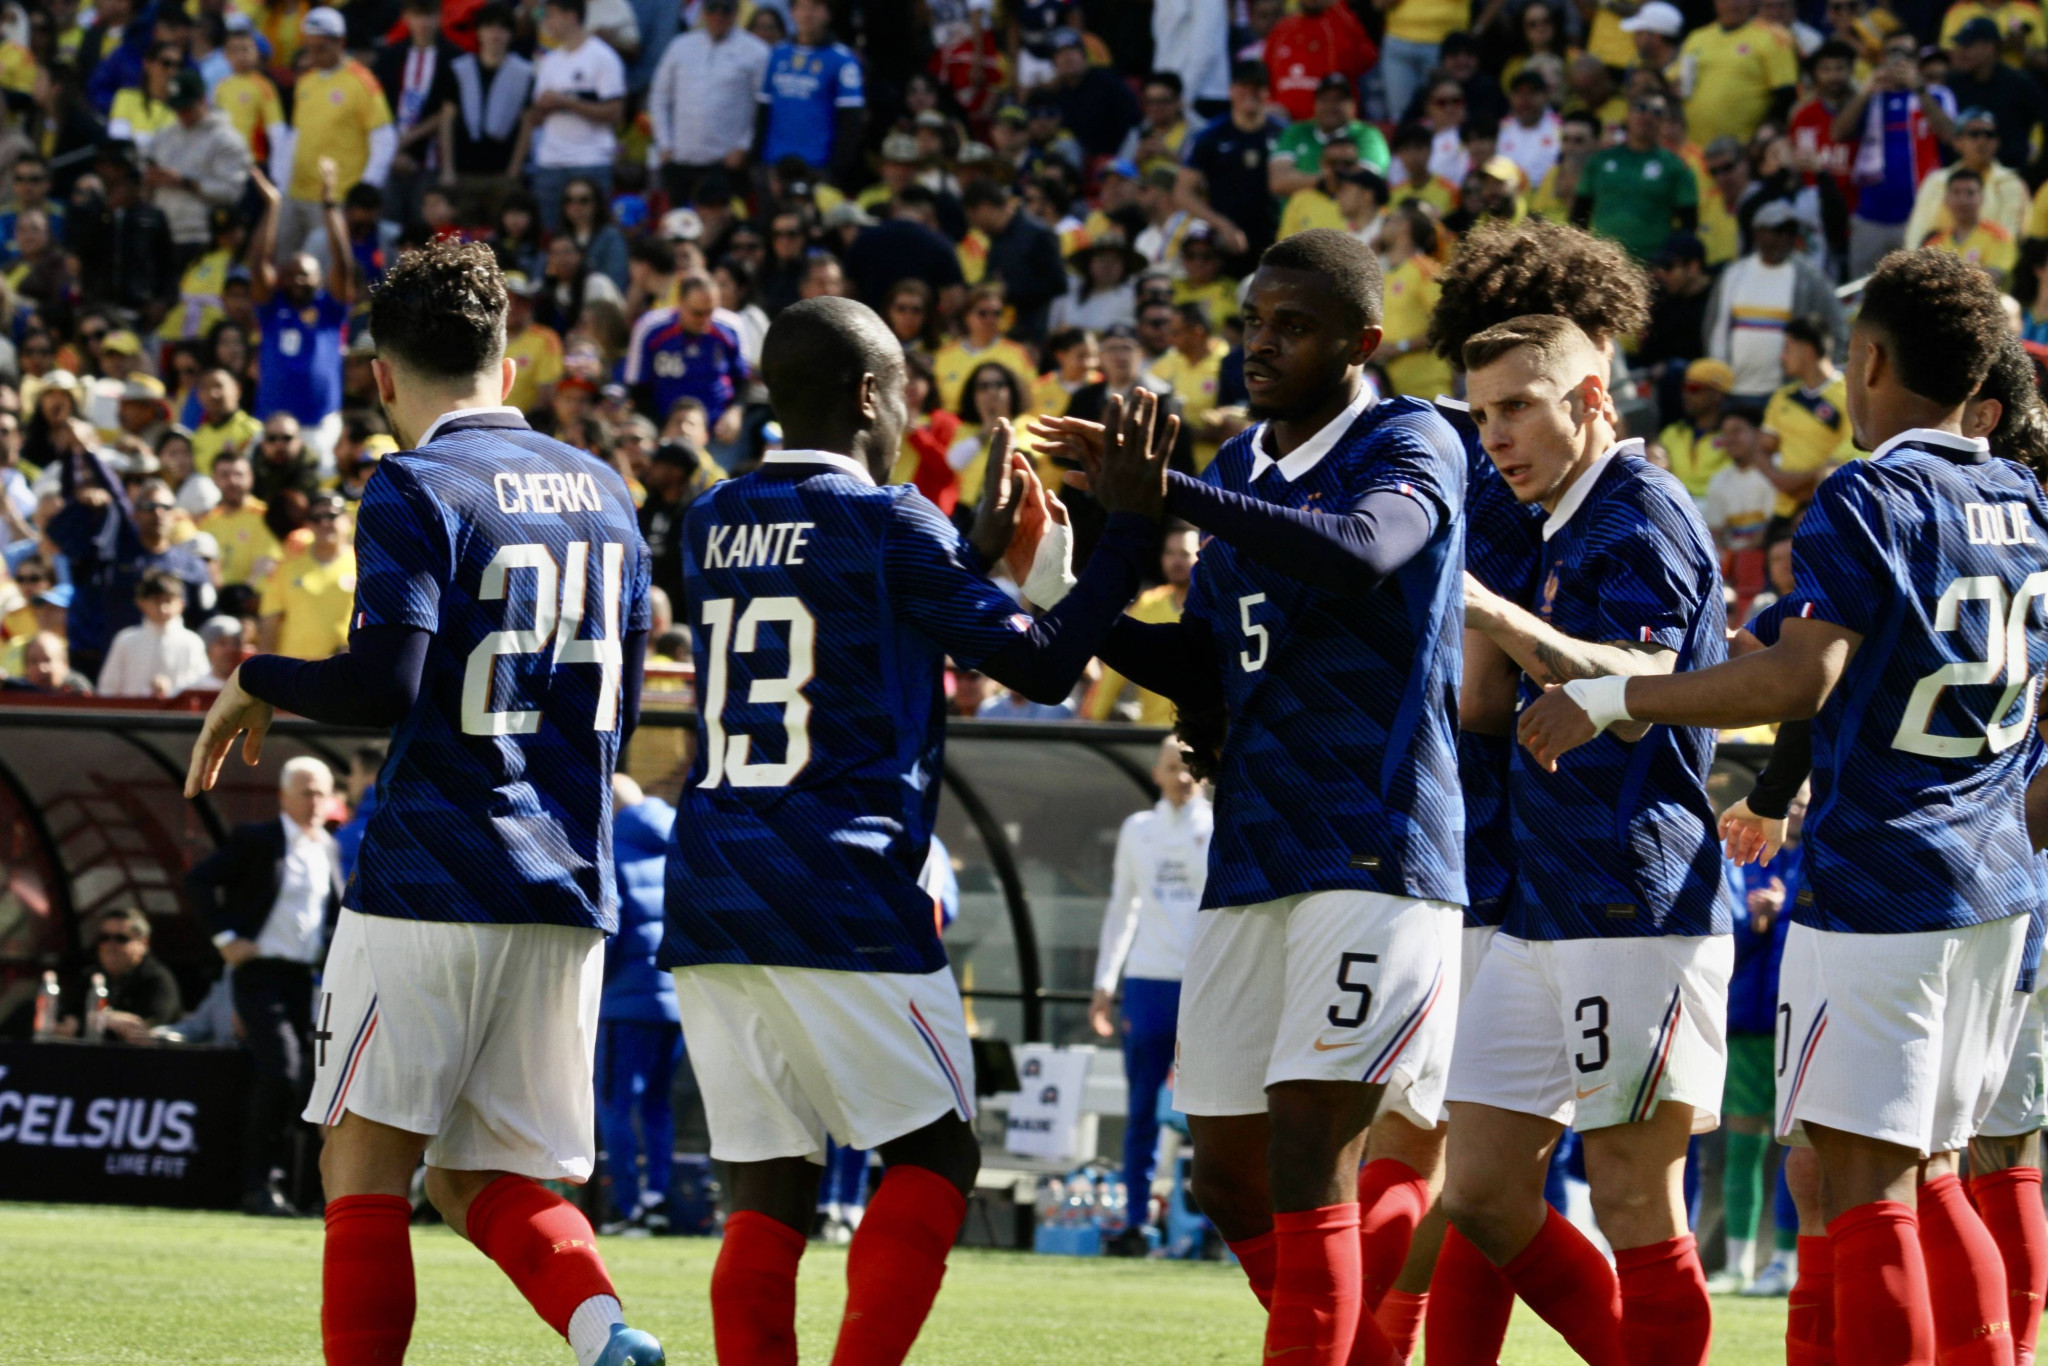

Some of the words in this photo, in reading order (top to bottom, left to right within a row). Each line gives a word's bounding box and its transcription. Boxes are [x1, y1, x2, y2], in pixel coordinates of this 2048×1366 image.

[494, 472, 602, 514] CHERKI
[1964, 502, 2036, 545] DOUE
[704, 522, 816, 569] KANTE
[461, 541, 624, 735] 24
[1239, 592, 1268, 672] 5
[1890, 571, 2048, 758] 20
[695, 596, 816, 788] 13
[1327, 952, 1378, 1028] 5
[1575, 995, 1609, 1073] 3
[0, 1090, 197, 1151] CELSIUS
